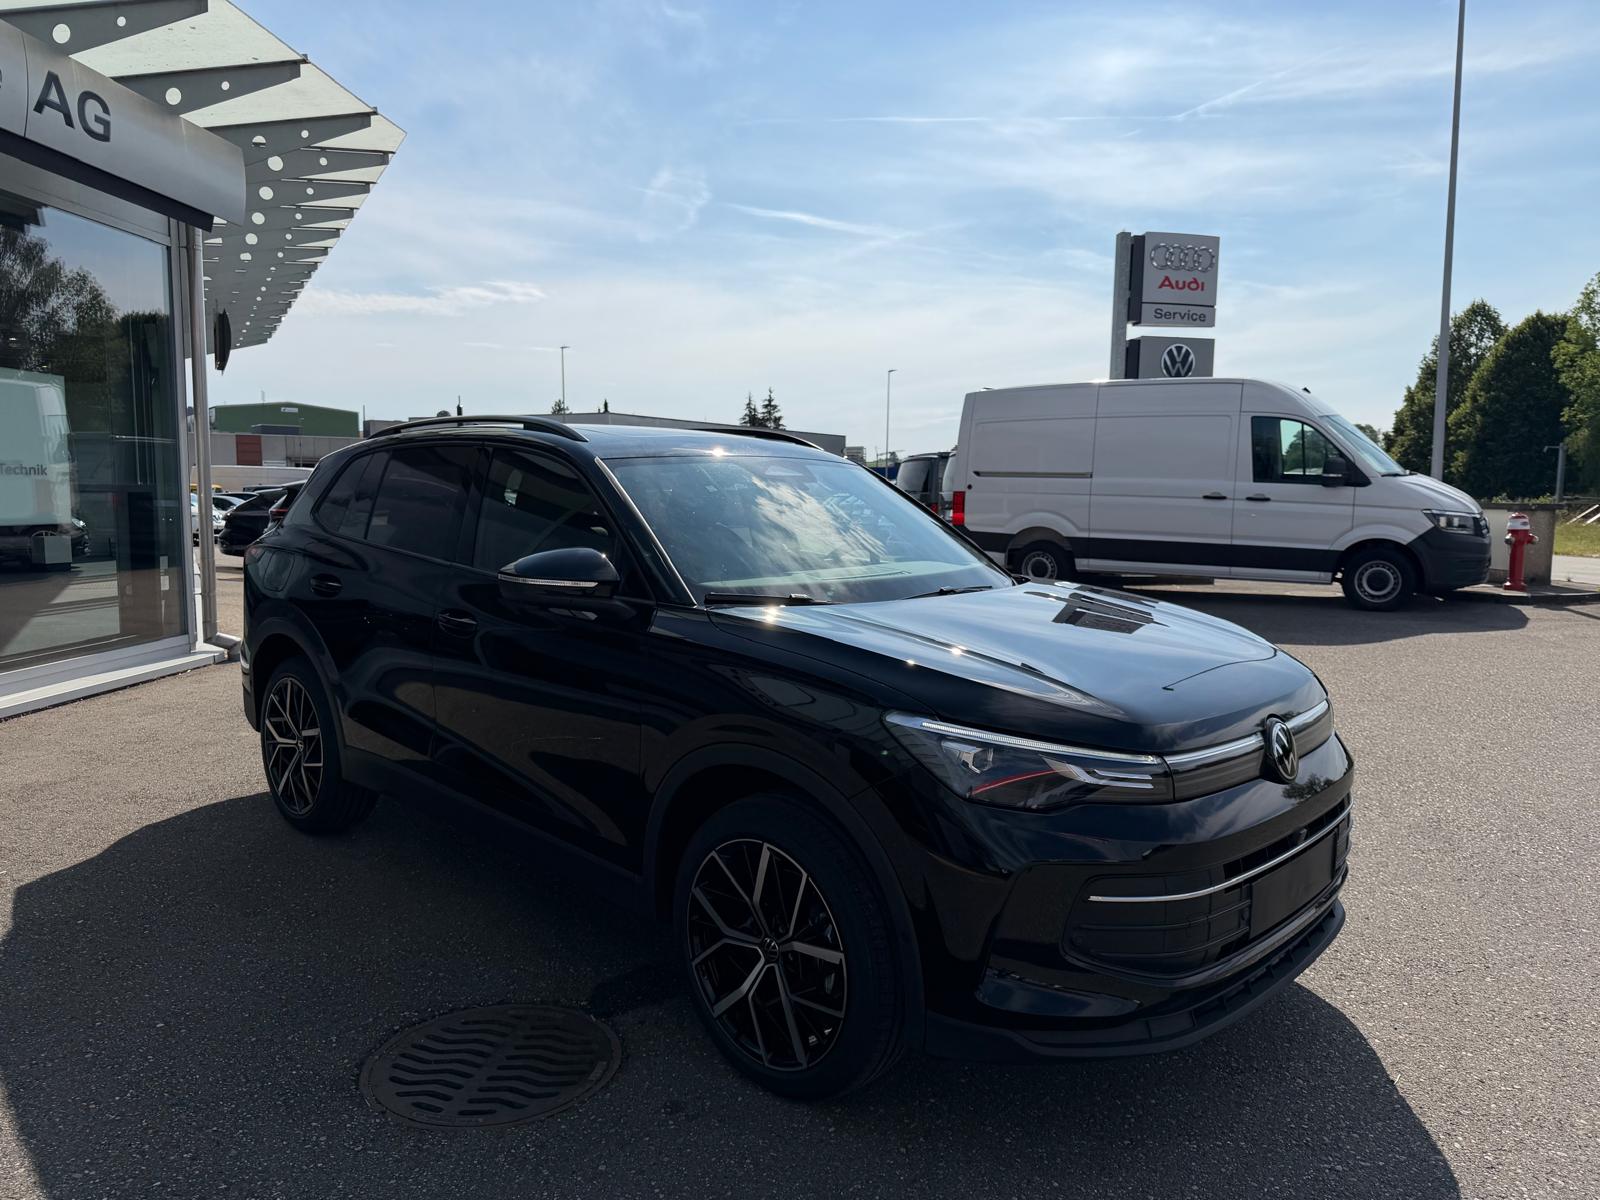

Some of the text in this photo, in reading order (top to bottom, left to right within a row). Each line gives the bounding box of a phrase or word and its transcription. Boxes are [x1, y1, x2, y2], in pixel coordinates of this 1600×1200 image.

[33, 70, 112, 142] AG
[1158, 275, 1205, 291] Audi
[1153, 308, 1206, 322] Service
[0, 463, 48, 476] Technik
